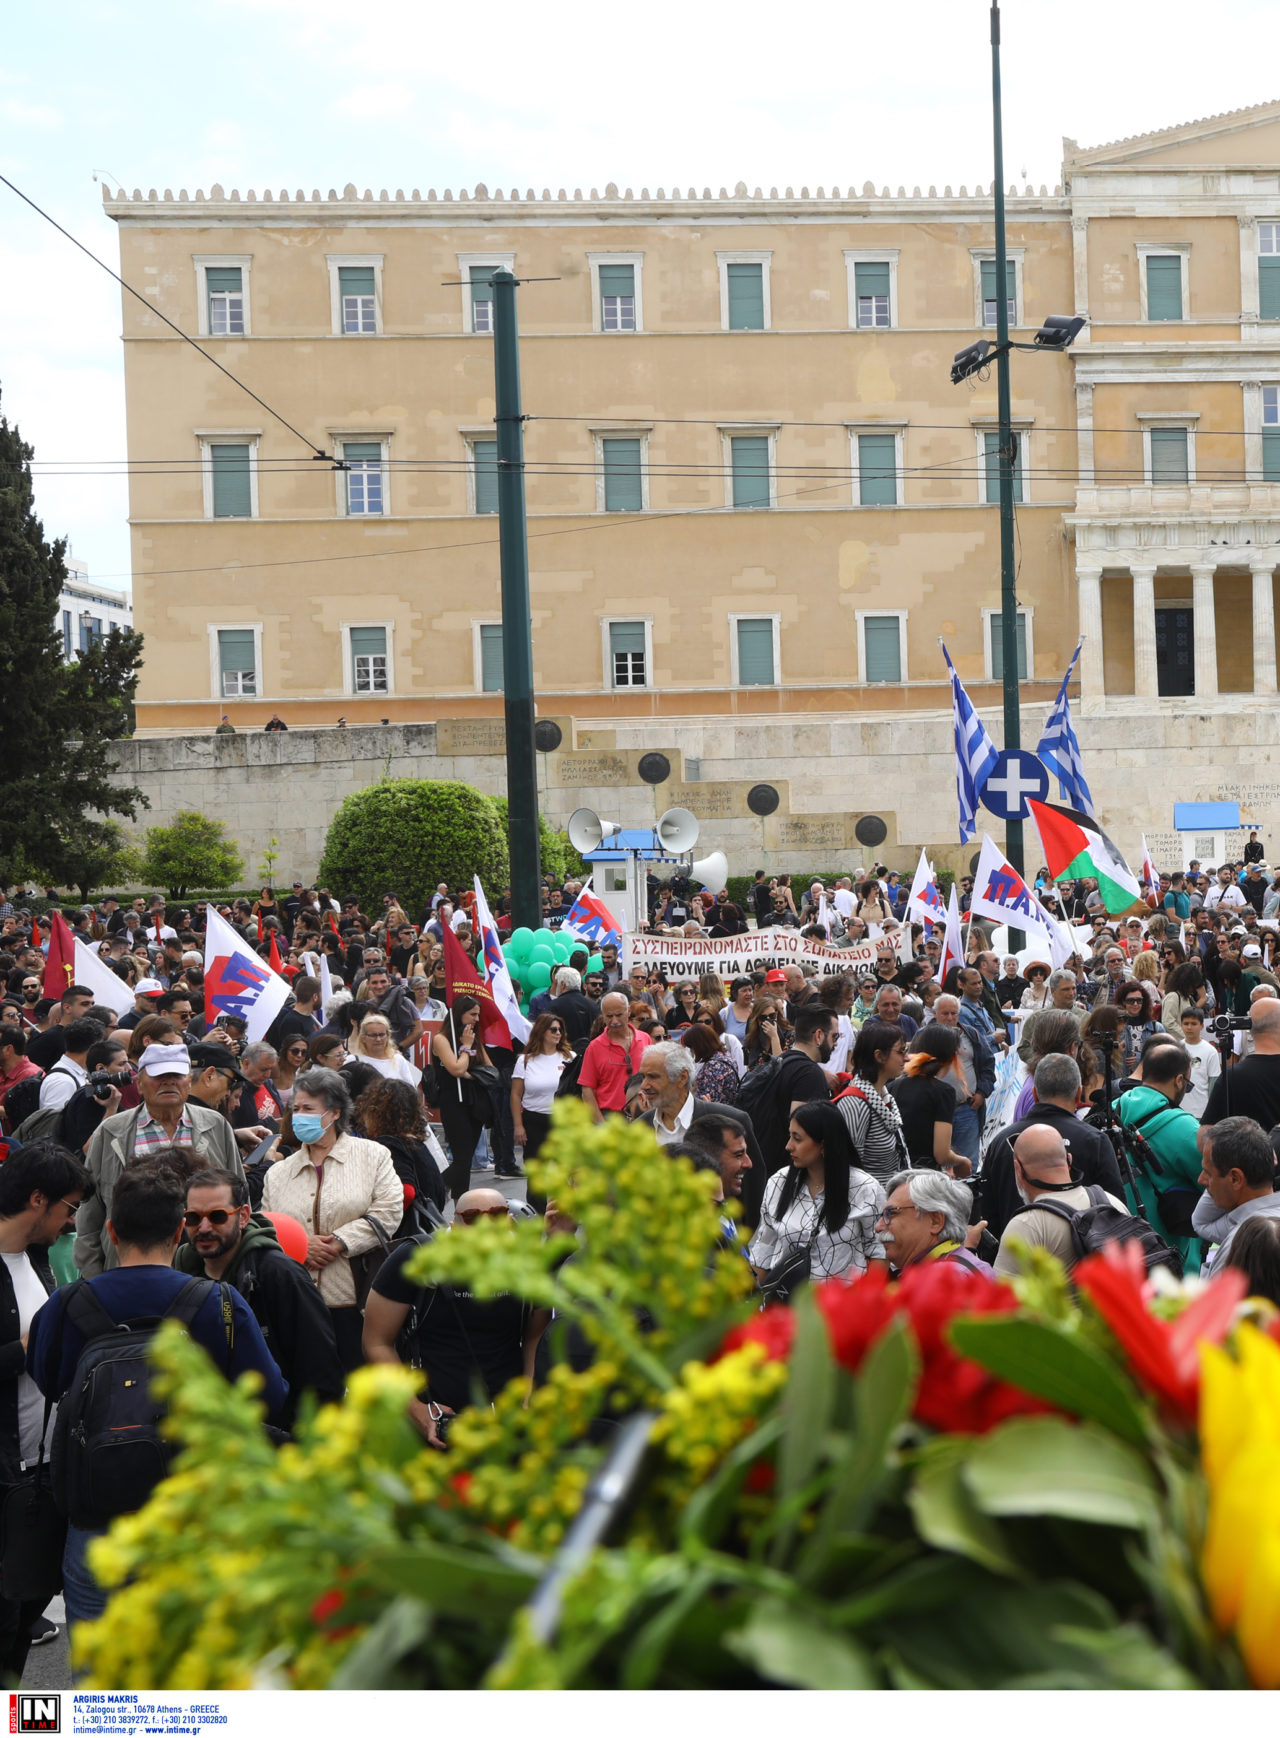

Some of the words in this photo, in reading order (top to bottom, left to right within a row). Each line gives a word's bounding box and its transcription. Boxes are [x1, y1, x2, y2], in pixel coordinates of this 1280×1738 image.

[632, 934, 769, 956] ΣΥΣΠΕΙΡΩΝΟΜΑΣΤΕ
[774, 934, 798, 952] ΣΤΟ
[719, 960, 740, 975] ΓΙΑ
